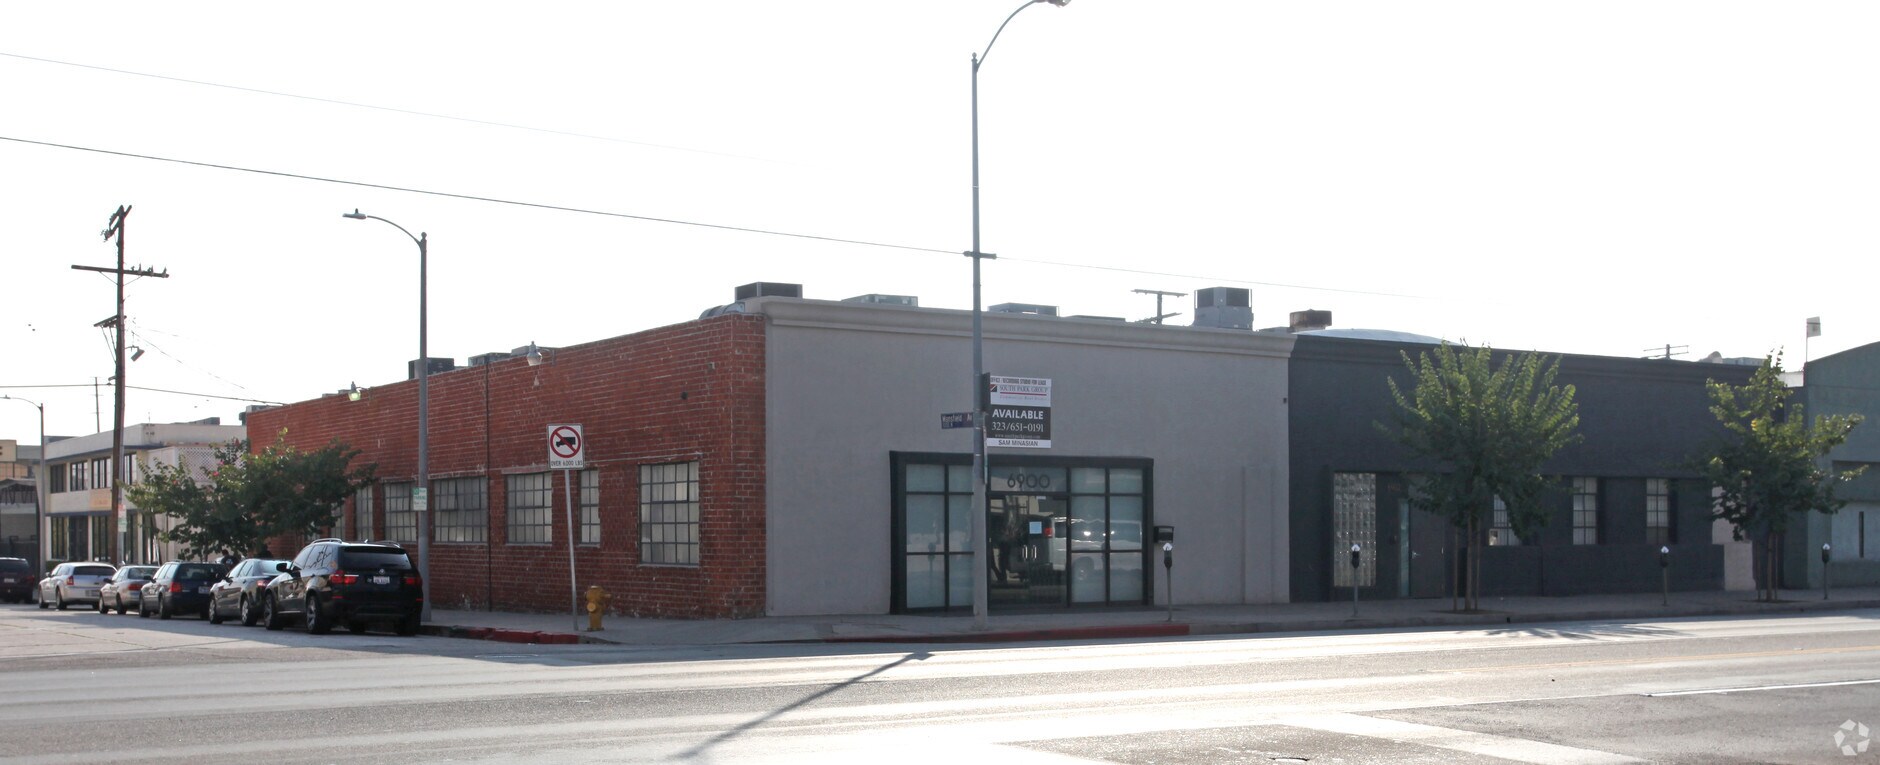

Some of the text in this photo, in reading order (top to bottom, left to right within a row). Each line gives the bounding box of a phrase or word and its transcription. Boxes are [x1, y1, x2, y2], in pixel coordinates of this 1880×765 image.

[999, 384, 1016, 392] SOUTH
[1017, 385, 1030, 393] PARK
[992, 408, 1044, 420] AVAILABLE
[992, 421, 1044, 432] 323/651-0191
[1007, 473, 1050, 489] 6900
